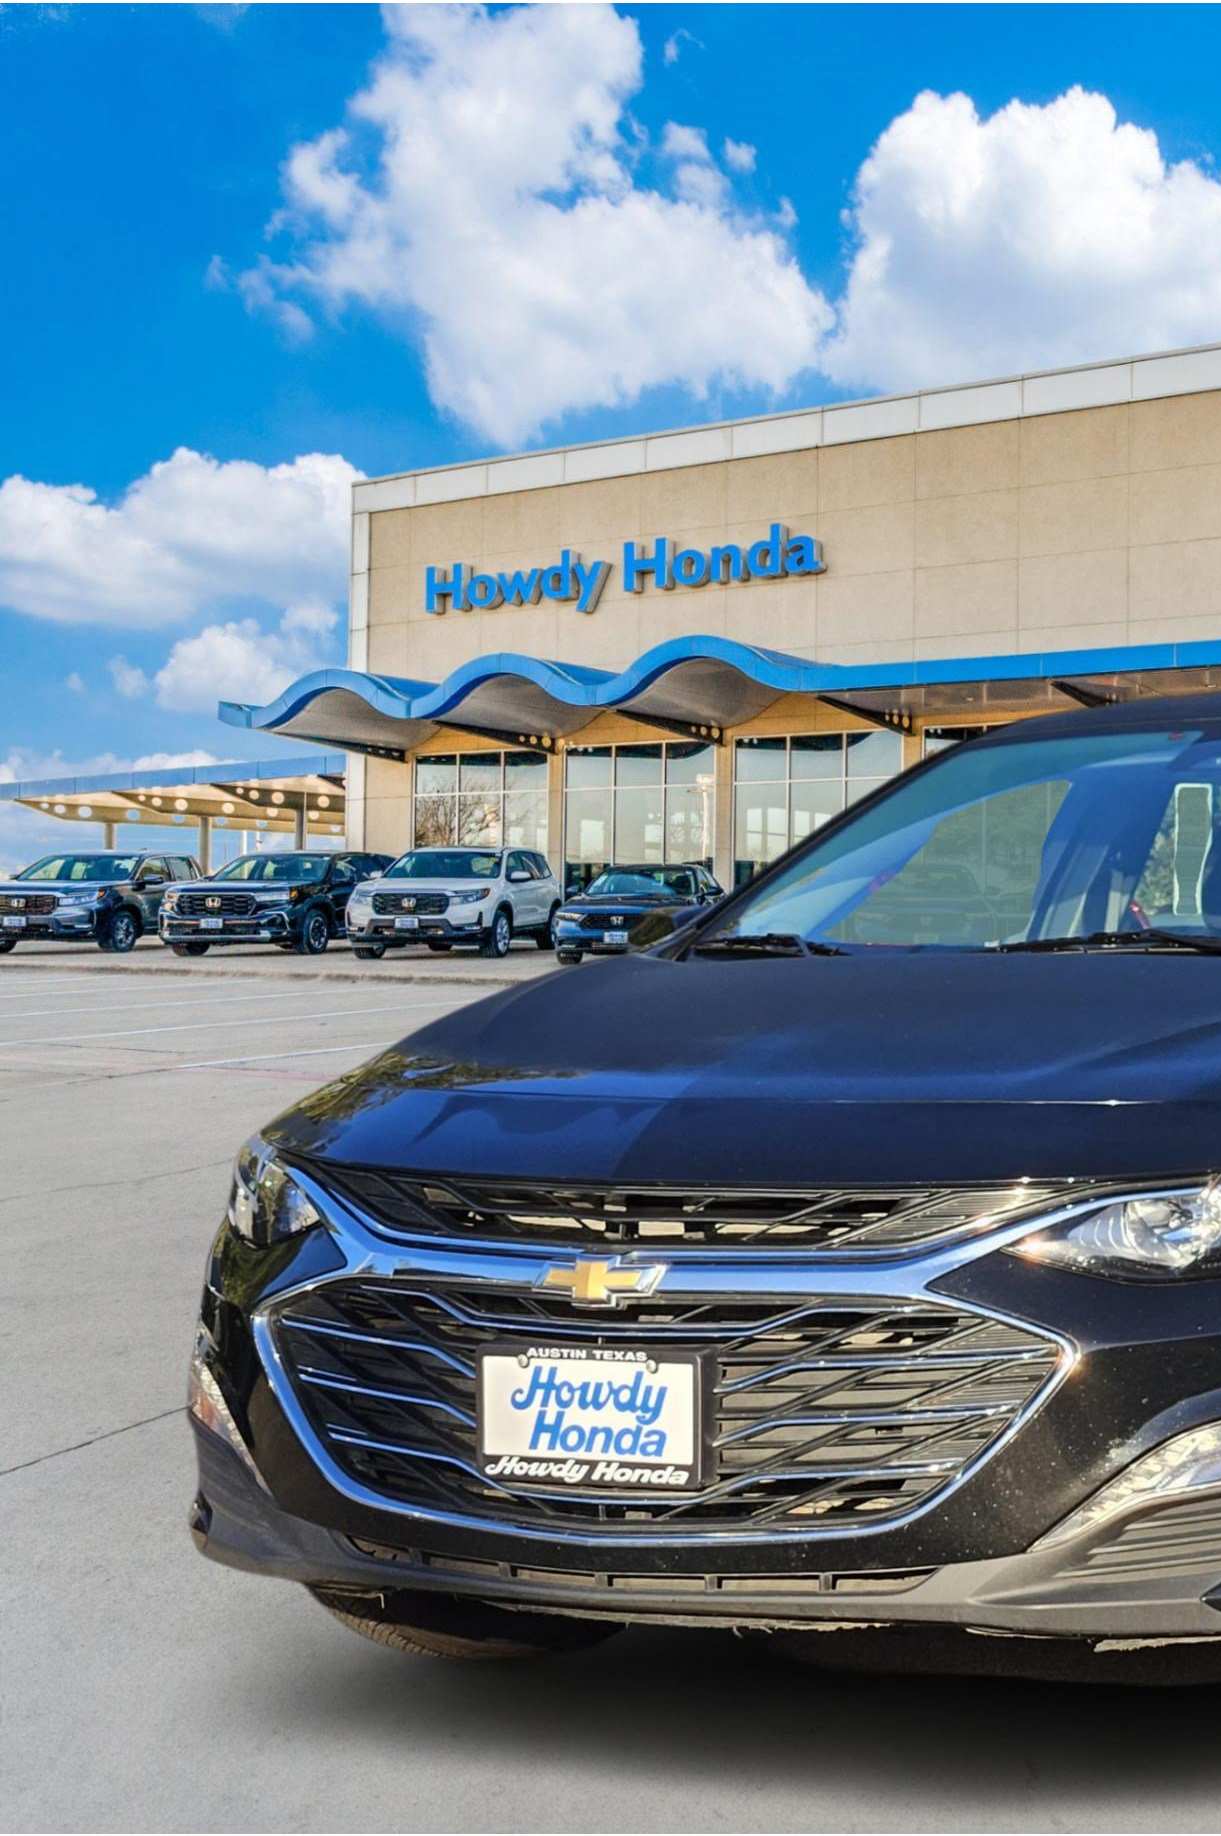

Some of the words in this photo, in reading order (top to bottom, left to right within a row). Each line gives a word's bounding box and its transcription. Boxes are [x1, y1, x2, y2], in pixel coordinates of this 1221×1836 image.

[425, 549, 611, 615] Howdy
[622, 523, 827, 594] Honda
[526, 1347, 587, 1360] AUSTIN
[592, 1349, 648, 1362] TEXAS
[510, 1365, 668, 1426] Howdy
[528, 1409, 668, 1458] Honda
[484, 1455, 590, 1484] Howdy
[591, 1460, 691, 1486] Honda
